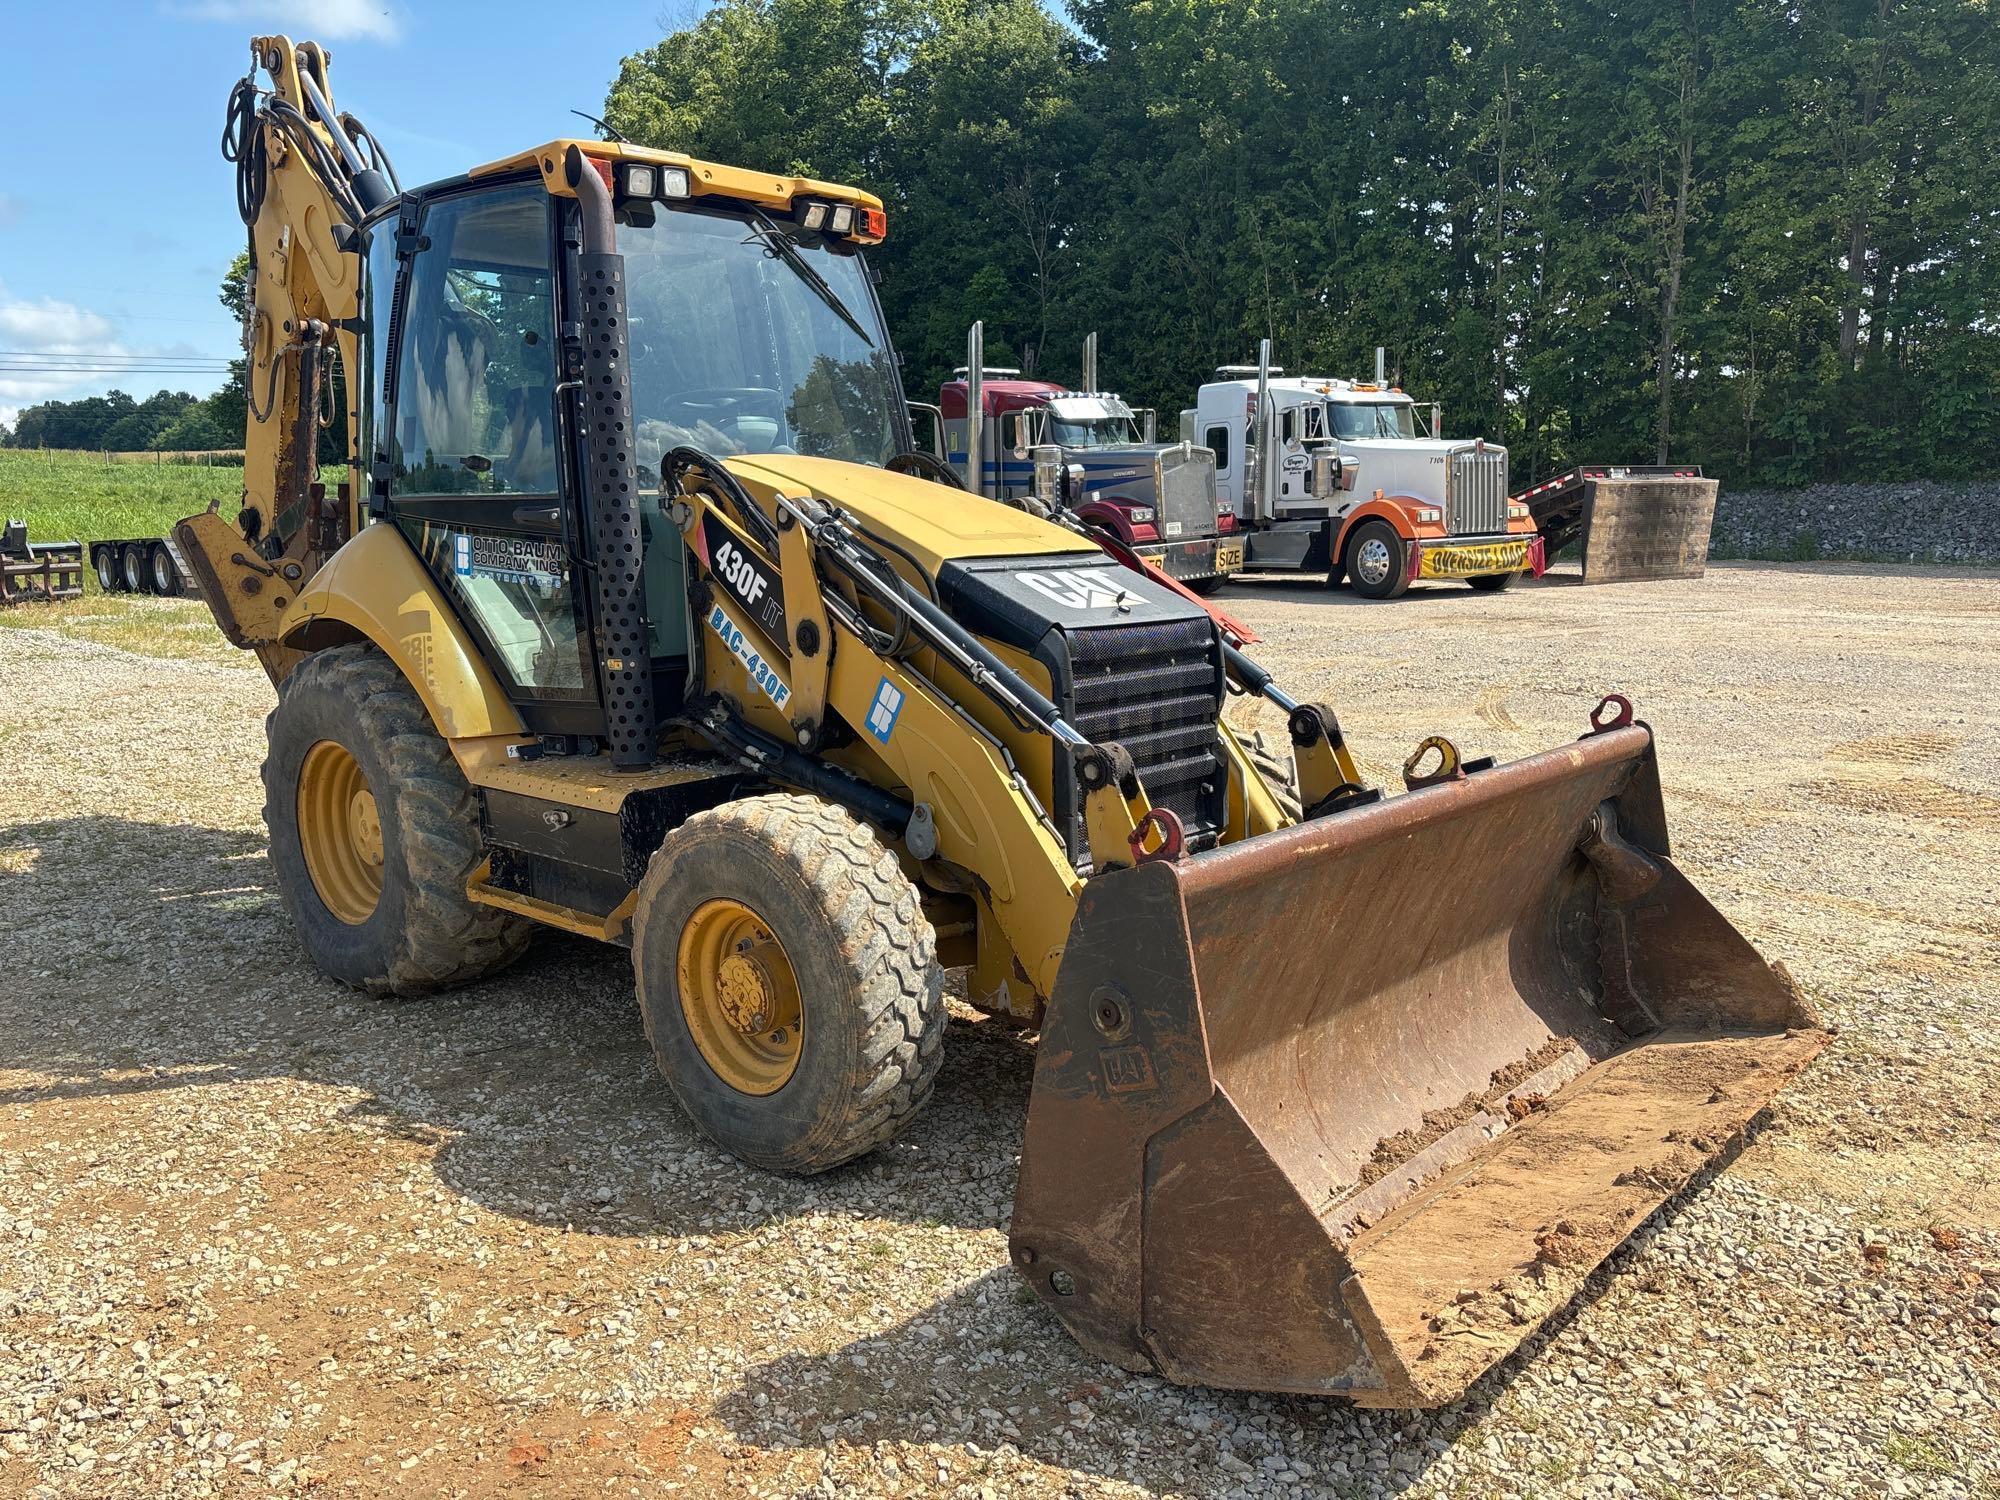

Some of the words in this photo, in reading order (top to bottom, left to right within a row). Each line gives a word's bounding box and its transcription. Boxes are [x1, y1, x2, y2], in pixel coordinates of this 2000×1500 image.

[473, 536, 508, 554] OTTO
[513, 541, 561, 560] BAUM
[1219, 549, 1240, 567] SIZE
[1432, 548, 1491, 573] OVERSIZE
[1494, 544, 1523, 570] LOAD
[469, 569, 561, 589] CONTRACTORS
[535, 560, 561, 574] INC.
[715, 541, 768, 605] 430F
[761, 596, 784, 629] IT
[1015, 570, 1152, 609] CAT
[711, 607, 788, 706] BAC-430F
